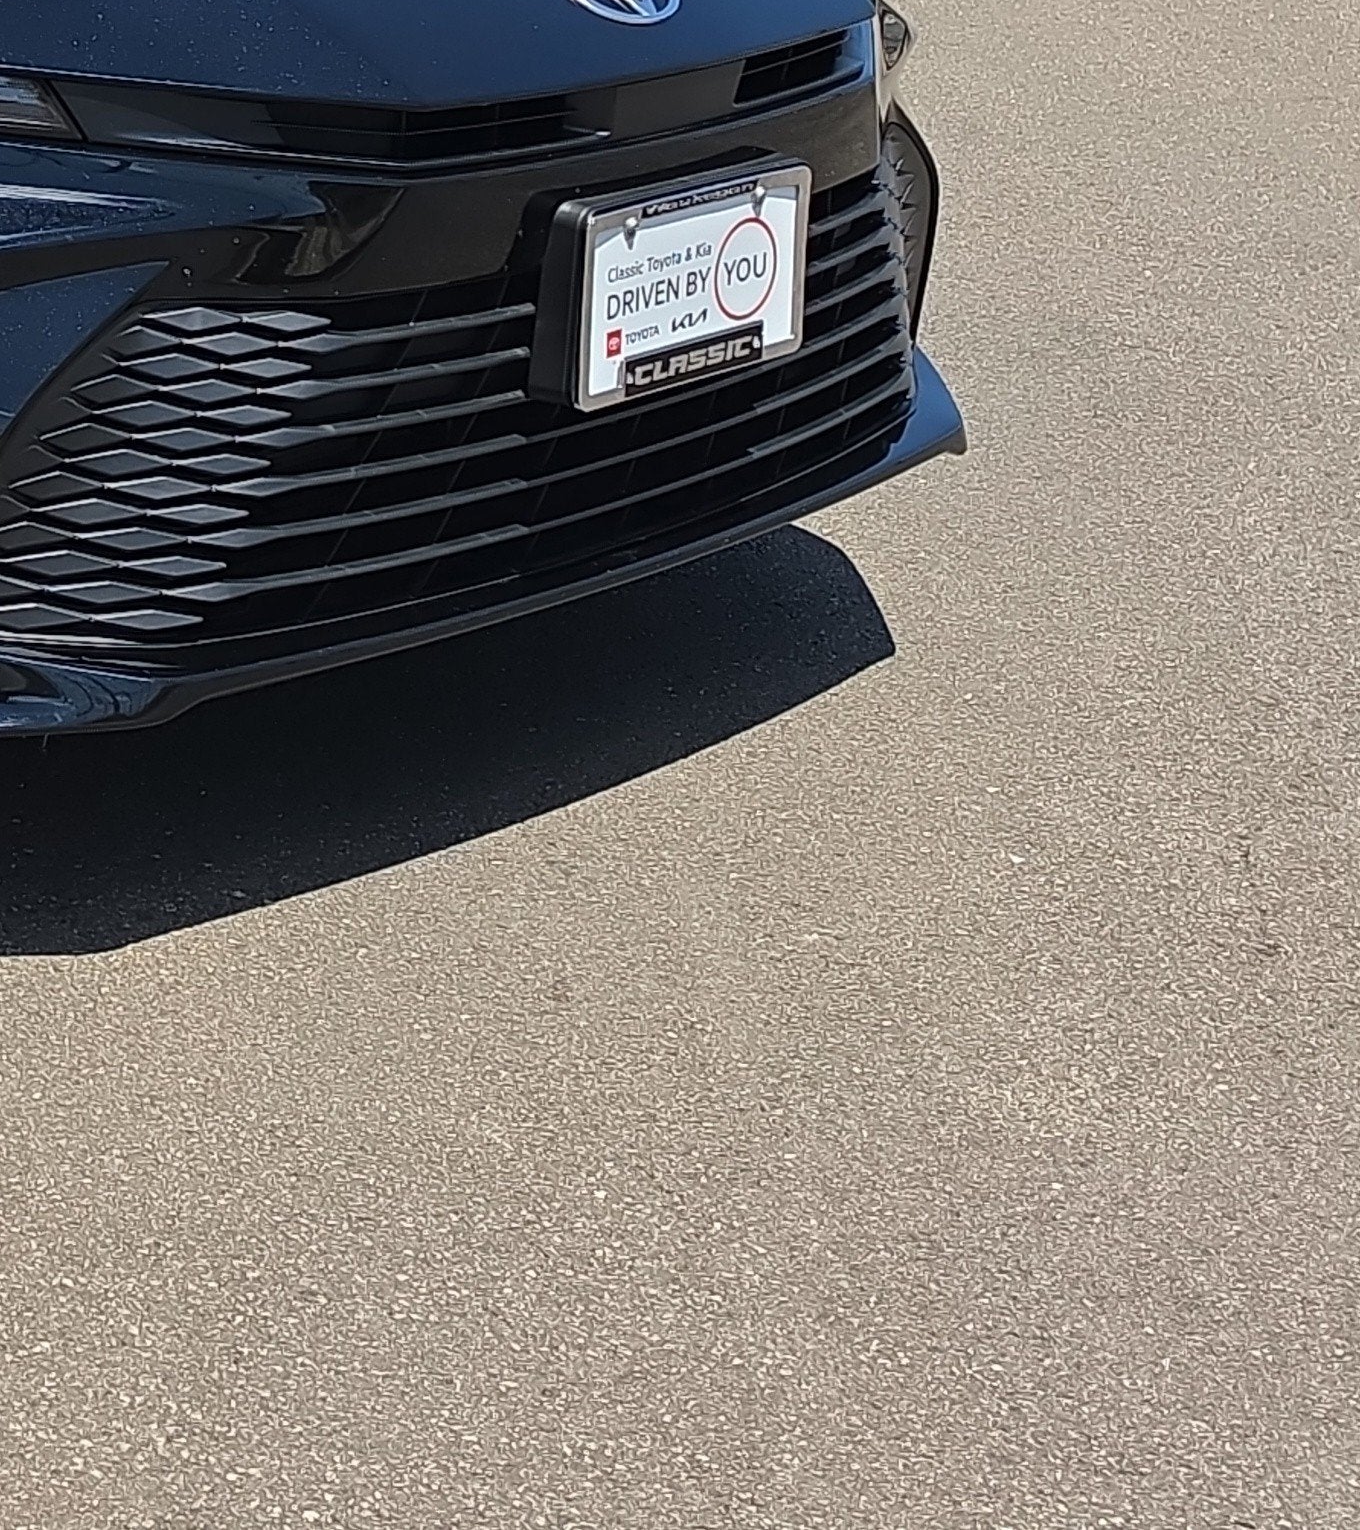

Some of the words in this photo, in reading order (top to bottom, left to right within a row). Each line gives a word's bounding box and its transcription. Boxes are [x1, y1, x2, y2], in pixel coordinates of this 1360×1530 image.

[607, 260, 645, 283] Classic
[646, 252, 682, 273] Toyota
[684, 246, 693, 262] &
[695, 242, 712, 259] Kia
[606, 274, 681, 321] DRIVEN
[685, 266, 712, 298] BY
[723, 251, 768, 287] YOU
[624, 324, 660, 346] TOYOTA
[633, 334, 753, 386] CLASSIC
